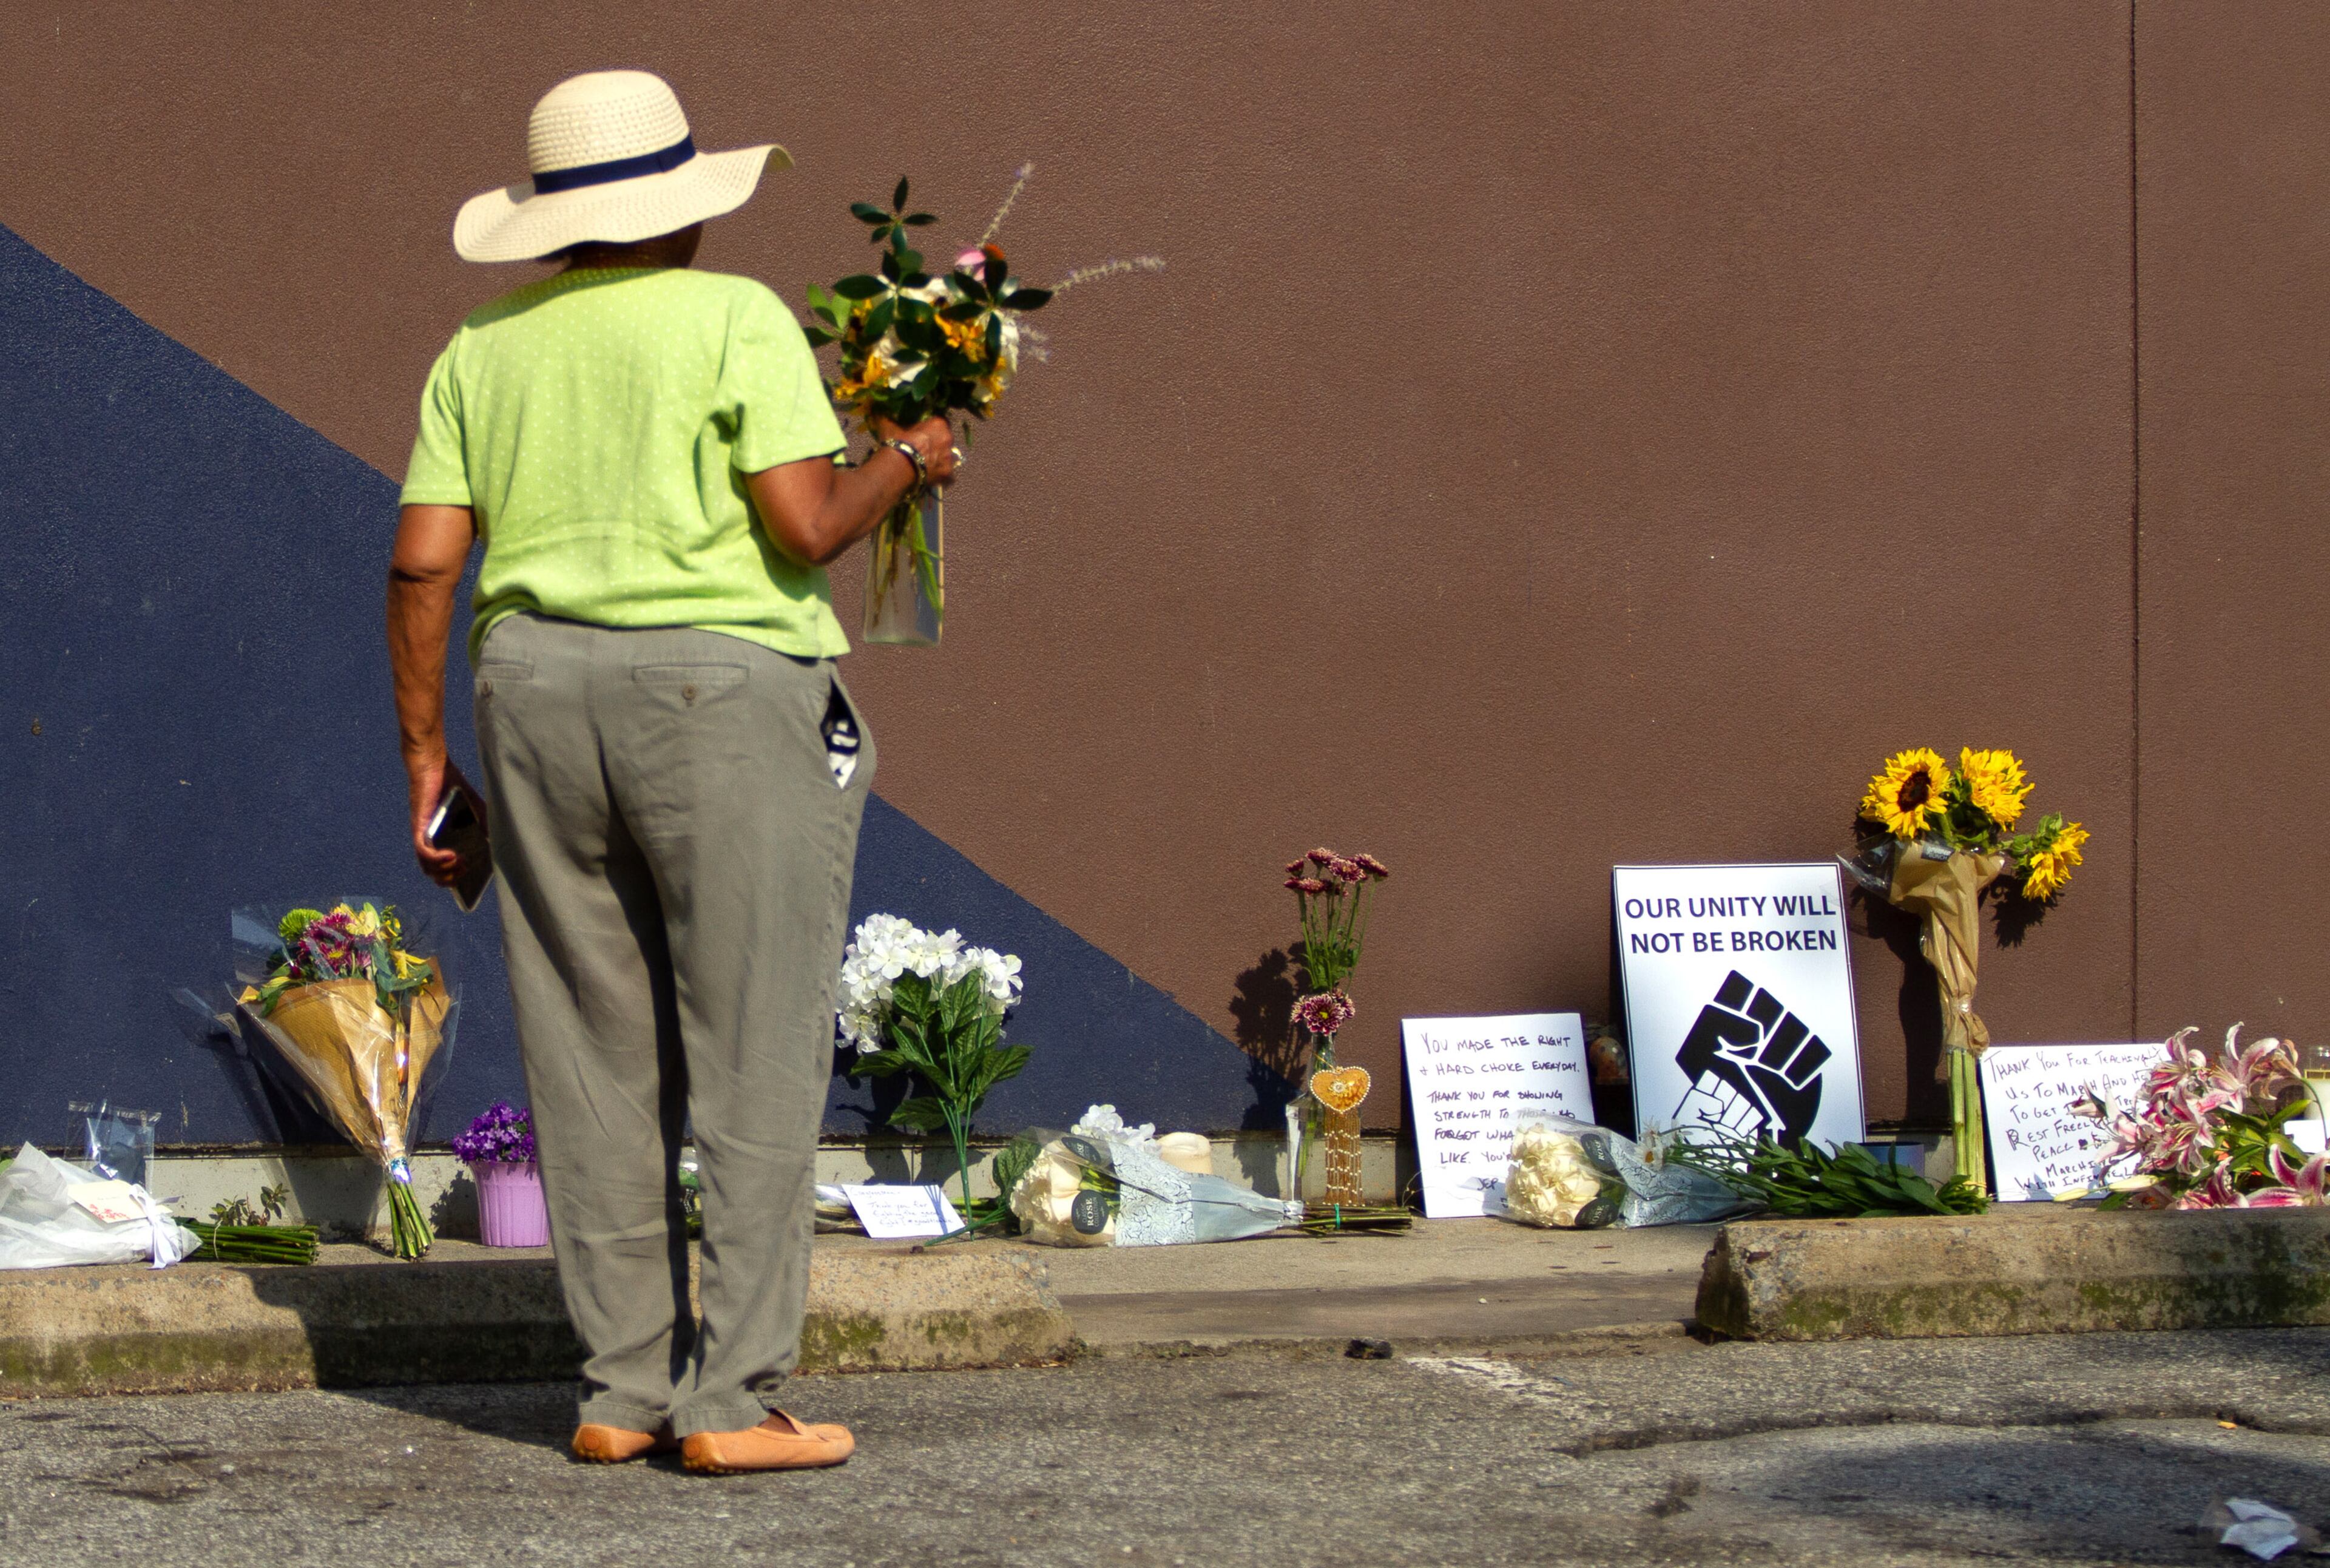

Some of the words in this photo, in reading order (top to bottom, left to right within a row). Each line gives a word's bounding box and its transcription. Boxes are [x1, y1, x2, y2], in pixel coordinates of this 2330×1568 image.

[1625, 897, 1681, 919] OUR
[1688, 896, 1767, 917] UNITY
[1772, 895, 1836, 916] WILL
[1631, 933, 1684, 953] NOT
[1693, 932, 1724, 952] BE
[1731, 930, 1837, 951] BROKEN
[1420, 1032, 1448, 1054] YOU
[1457, 1039, 1494, 1053] MADE
[1501, 1036, 1530, 1047] THE
[1538, 1035, 1570, 1047] RIGHT
[1436, 1063, 1474, 1075] HARD
[2056, 1080, 2098, 1096] MARH
[1427, 1090, 1461, 1103] THANK
[1467, 1091, 1485, 1101] YOU
[1493, 1090, 1510, 1098] FOR
[1518, 1090, 1562, 1101] SHOWING
[1434, 1109, 1491, 1121] STRENGTH
[1499, 1108, 1509, 1119] TO
[1518, 1109, 1546, 1119] THOS
[1487, 1129, 1515, 1141] WHA
[1481, 1151, 1518, 1163] YOU'R
[1086, 1198, 1094, 1226] ROSE
